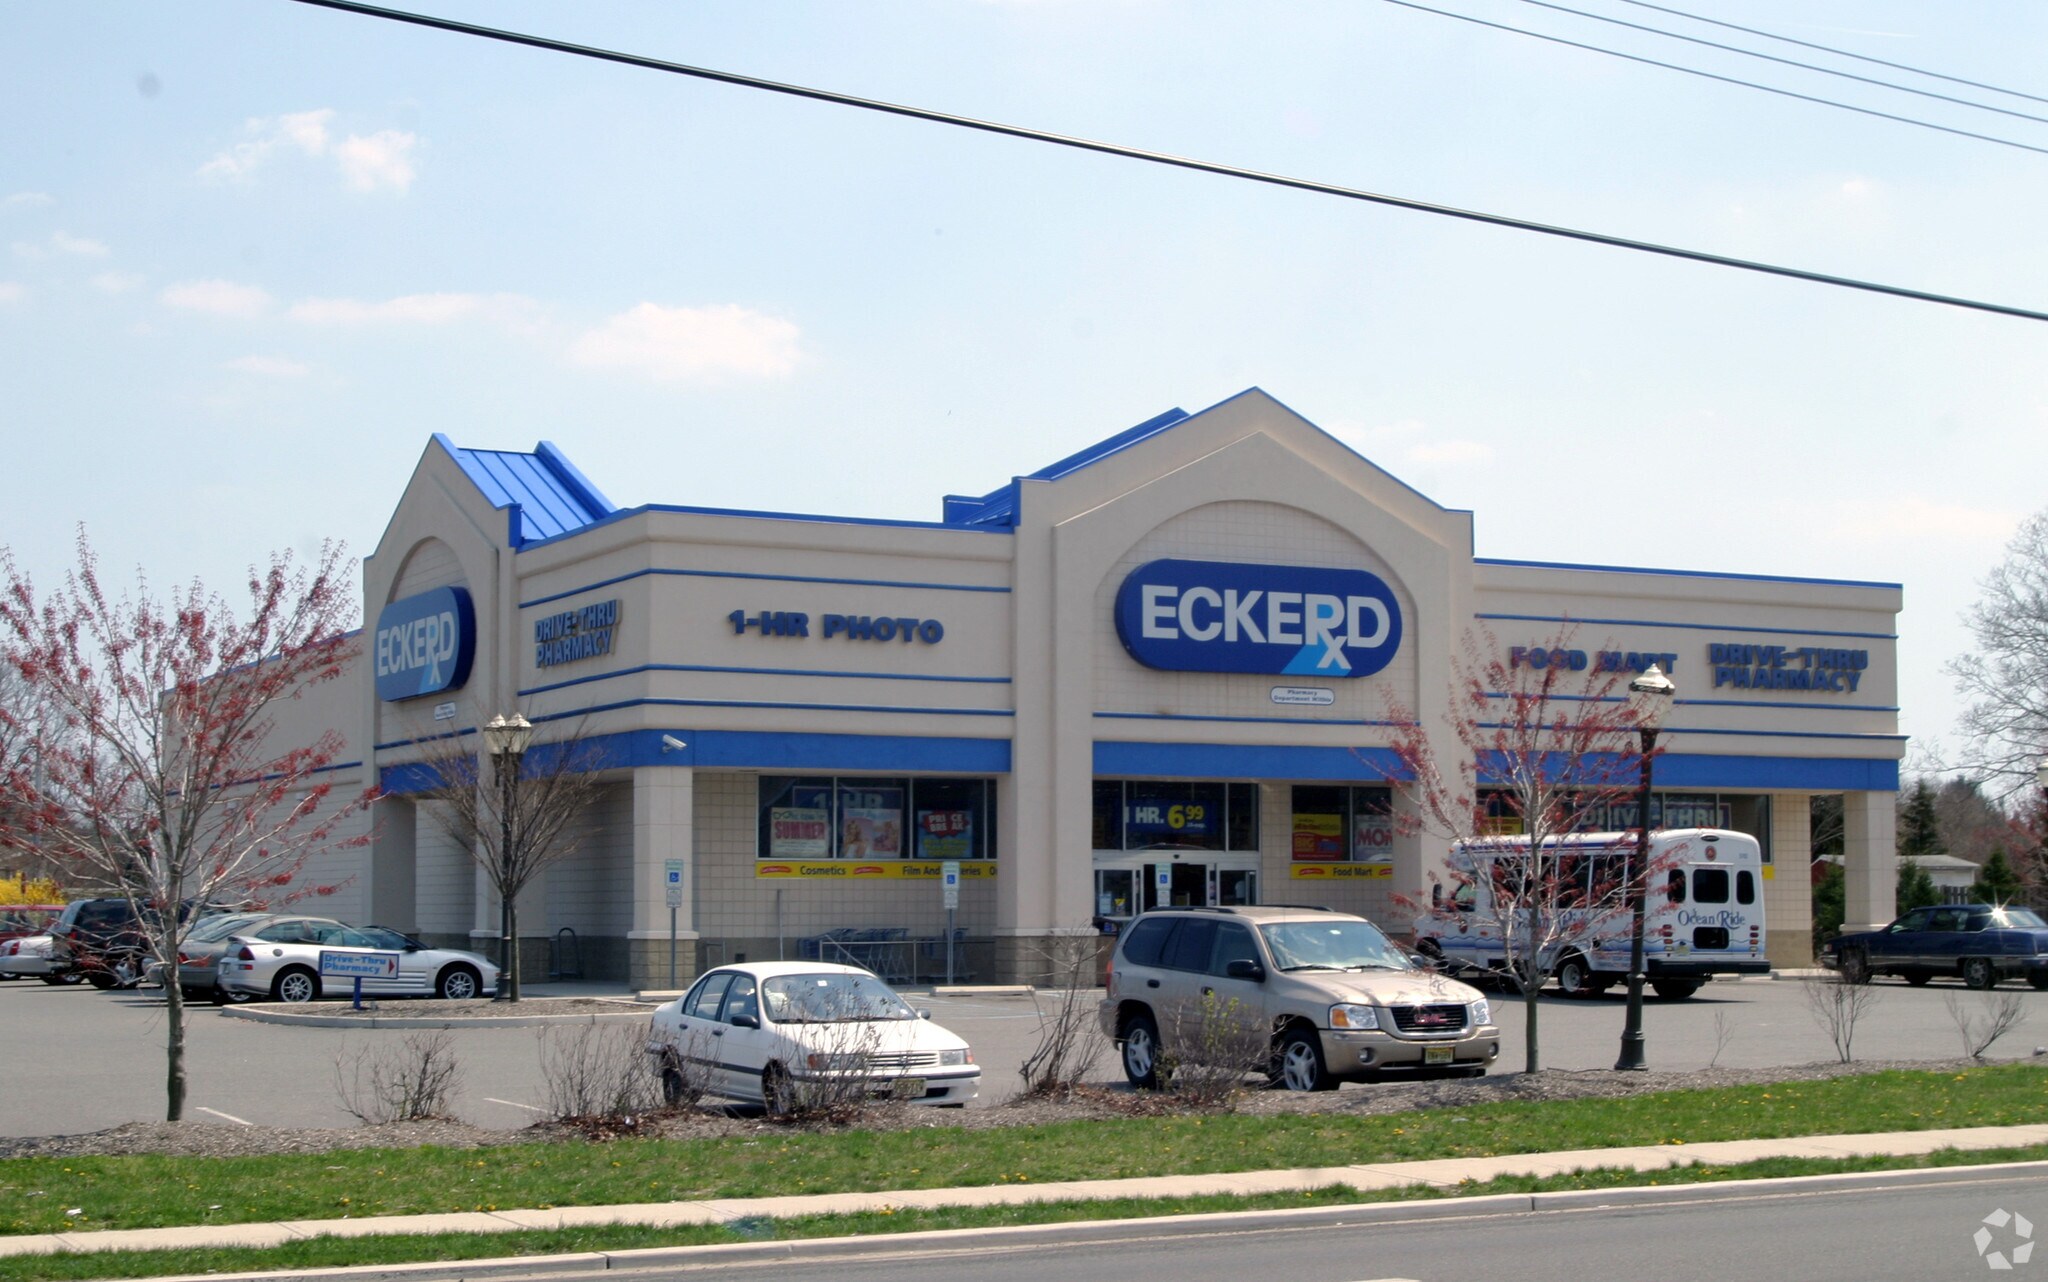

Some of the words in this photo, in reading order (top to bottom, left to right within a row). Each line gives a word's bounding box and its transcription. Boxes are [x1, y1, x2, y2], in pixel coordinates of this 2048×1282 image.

[535, 599, 618, 643] DRIVE-THRU
[728, 610, 809, 637] 1-HR
[823, 613, 944, 644] PHOTO
[1142, 584, 1391, 648] ECKERD
[378, 611, 456, 677] ECKERD
[535, 629, 613, 668] PHARMACY
[1710, 643, 1869, 670] DRIVE-THRU
[1511, 646, 1588, 671] FOOD
[1715, 665, 1861, 692] PHARMACY
[1287, 689, 1317, 697] Pharmacy
[800, 865, 846, 875] Cosmetics
[903, 866, 921, 875] Film
[923, 866, 941, 875] And
[1333, 868, 1353, 876] Food
[1354, 868, 1373, 876] Mart
[1678, 908, 1715, 926] Ocean
[1717, 910, 1746, 930] Ride
[324, 954, 386, 965] Drive-Thru
[324, 962, 380, 974] Pharmacy
